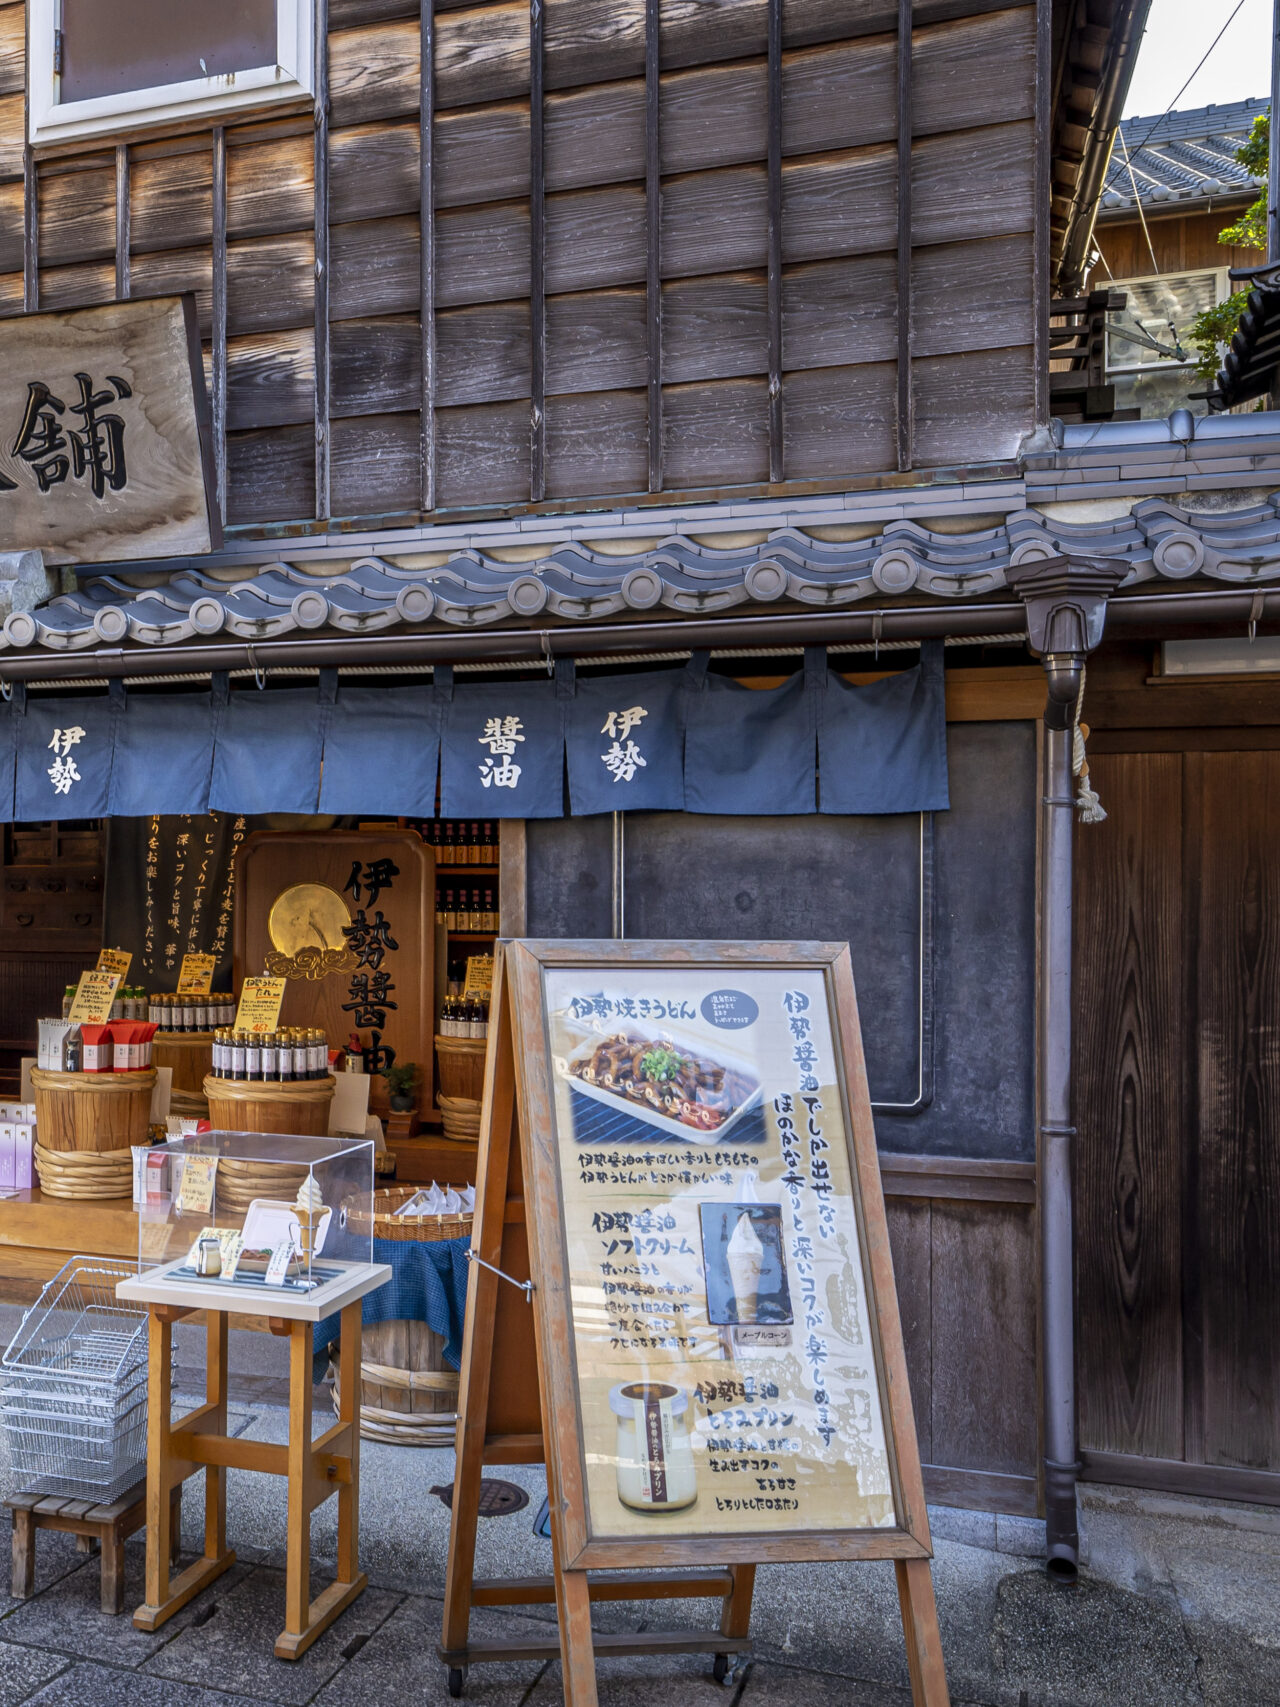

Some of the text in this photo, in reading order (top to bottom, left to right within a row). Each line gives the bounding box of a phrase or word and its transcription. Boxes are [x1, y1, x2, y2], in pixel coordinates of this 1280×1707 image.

[601, 706, 648, 783] 伊勢
[47, 726, 86, 795] 伊勢
[570, 997, 697, 1020] 伊勢焼きうどん
[601, 1235, 696, 1256] ソフトクリーム
[600, 1261, 660, 1276] 甘いバニラと
[773, 1093, 836, 1447] ほのかな香りと深いコクが楽しめます
[706, 1406, 794, 1430] とろみプリン
[709, 1459, 780, 1473] 生み出すコクの
[755, 1477, 797, 1491] ある甘さ
[715, 1496, 799, 1511] とろりとした口あたり
